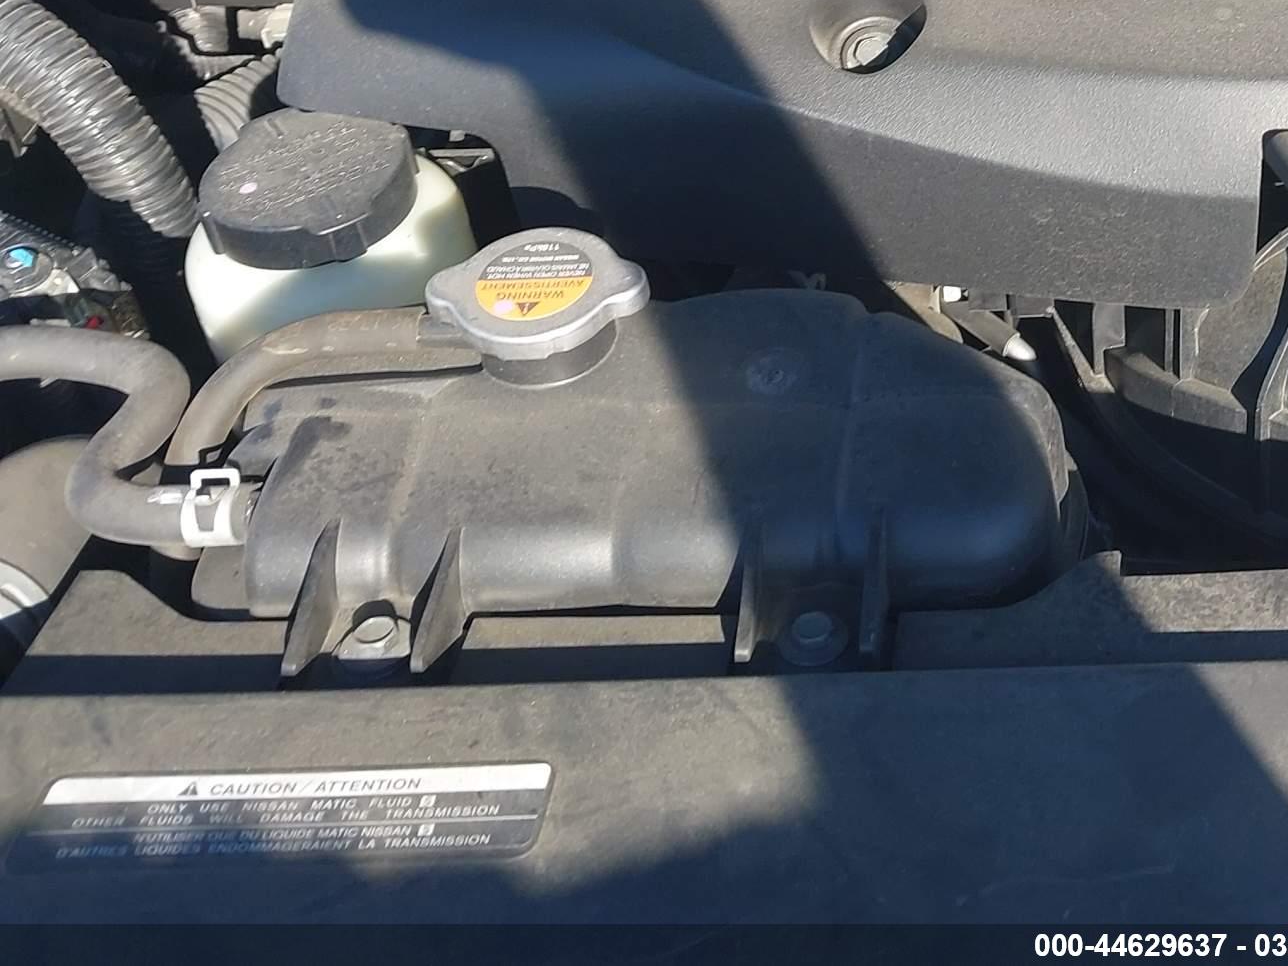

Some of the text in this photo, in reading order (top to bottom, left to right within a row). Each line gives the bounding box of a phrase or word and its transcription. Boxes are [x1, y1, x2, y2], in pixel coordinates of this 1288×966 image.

[481, 279, 585, 291] AVERTISSEMENT
[496, 290, 564, 301] WARNING
[210, 781, 297, 797] CAUTION
[315, 777, 422, 794] ATTENTION
[147, 803, 188, 814] ONLY
[200, 802, 229, 813] USE
[242, 800, 299, 812] NISSAN
[311, 798, 357, 811] MATIC
[369, 796, 412, 809] FLUID
[71, 805, 502, 828] OTHER FLUIDS WILL DAMAGE THE TRANSMISSION
[261, 827, 317, 840] LIQUIDE
[317, 827, 359, 839] MATIC
[360, 825, 413, 838] NISSAN
[134, 842, 202, 856] LIQUIDES
[207, 839, 352, 855] ENDOMMAGERAIENT
[358, 837, 376, 850] LA
[383, 834, 492, 850] TRANSMISSION
